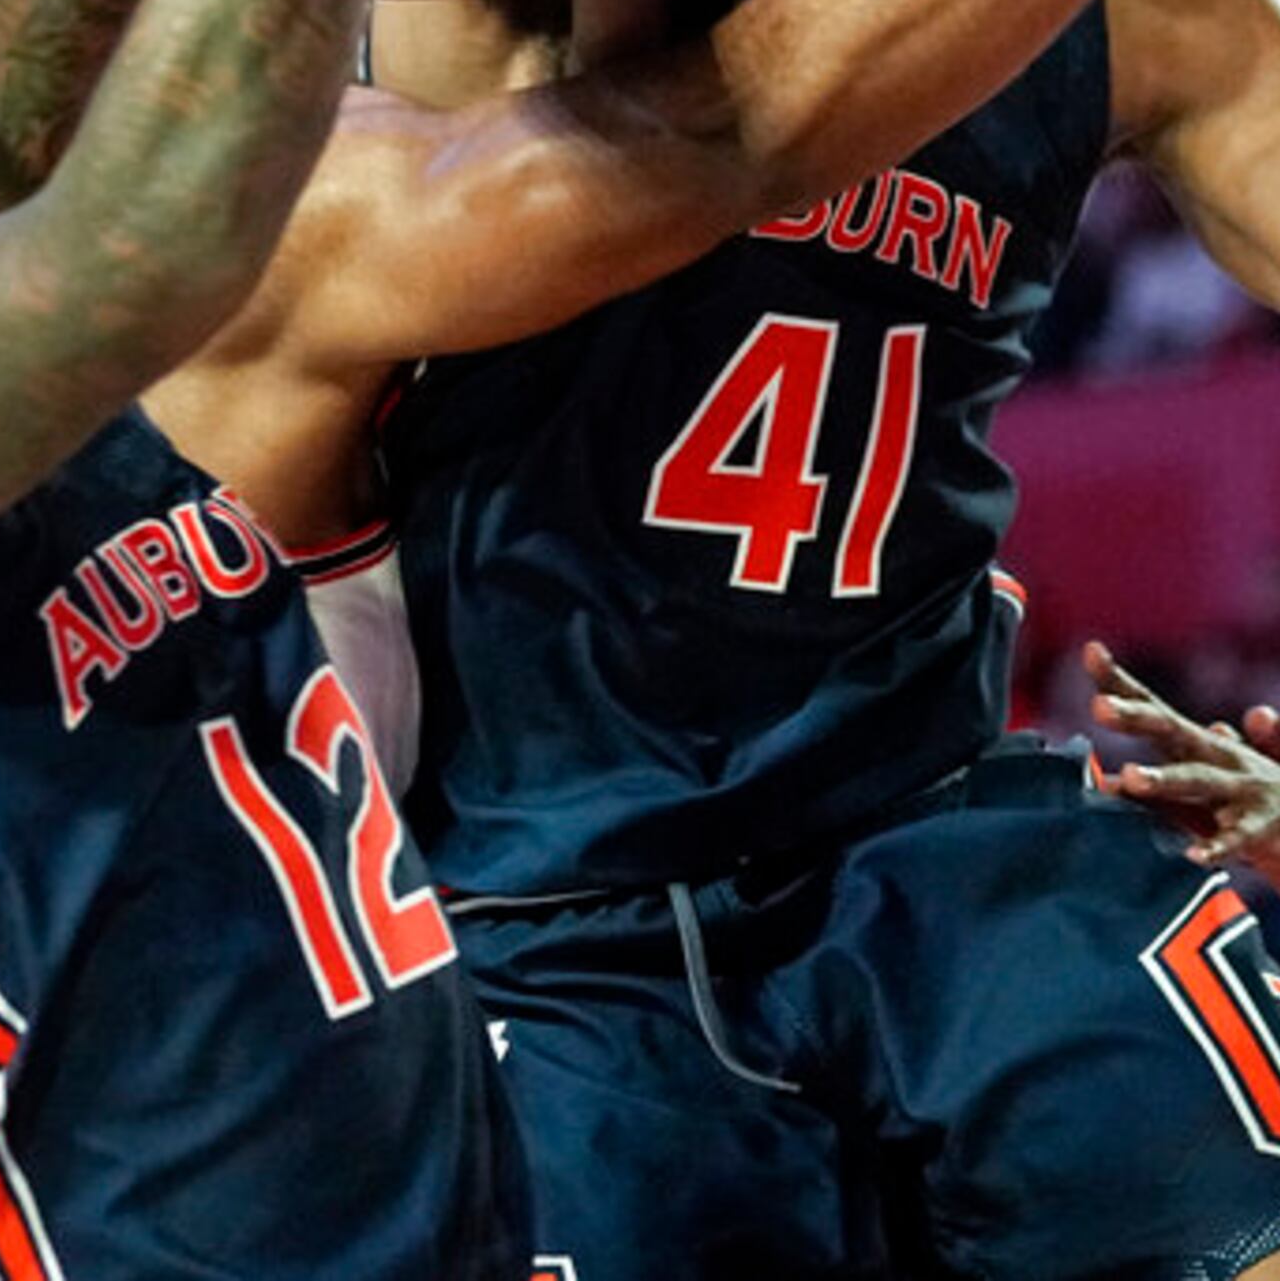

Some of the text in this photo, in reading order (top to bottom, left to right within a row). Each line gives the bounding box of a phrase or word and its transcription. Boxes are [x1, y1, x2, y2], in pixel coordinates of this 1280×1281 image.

[641, 312, 927, 598] 41
[40, 484, 288, 730] AUBU
[199, 665, 458, 1020] 12
